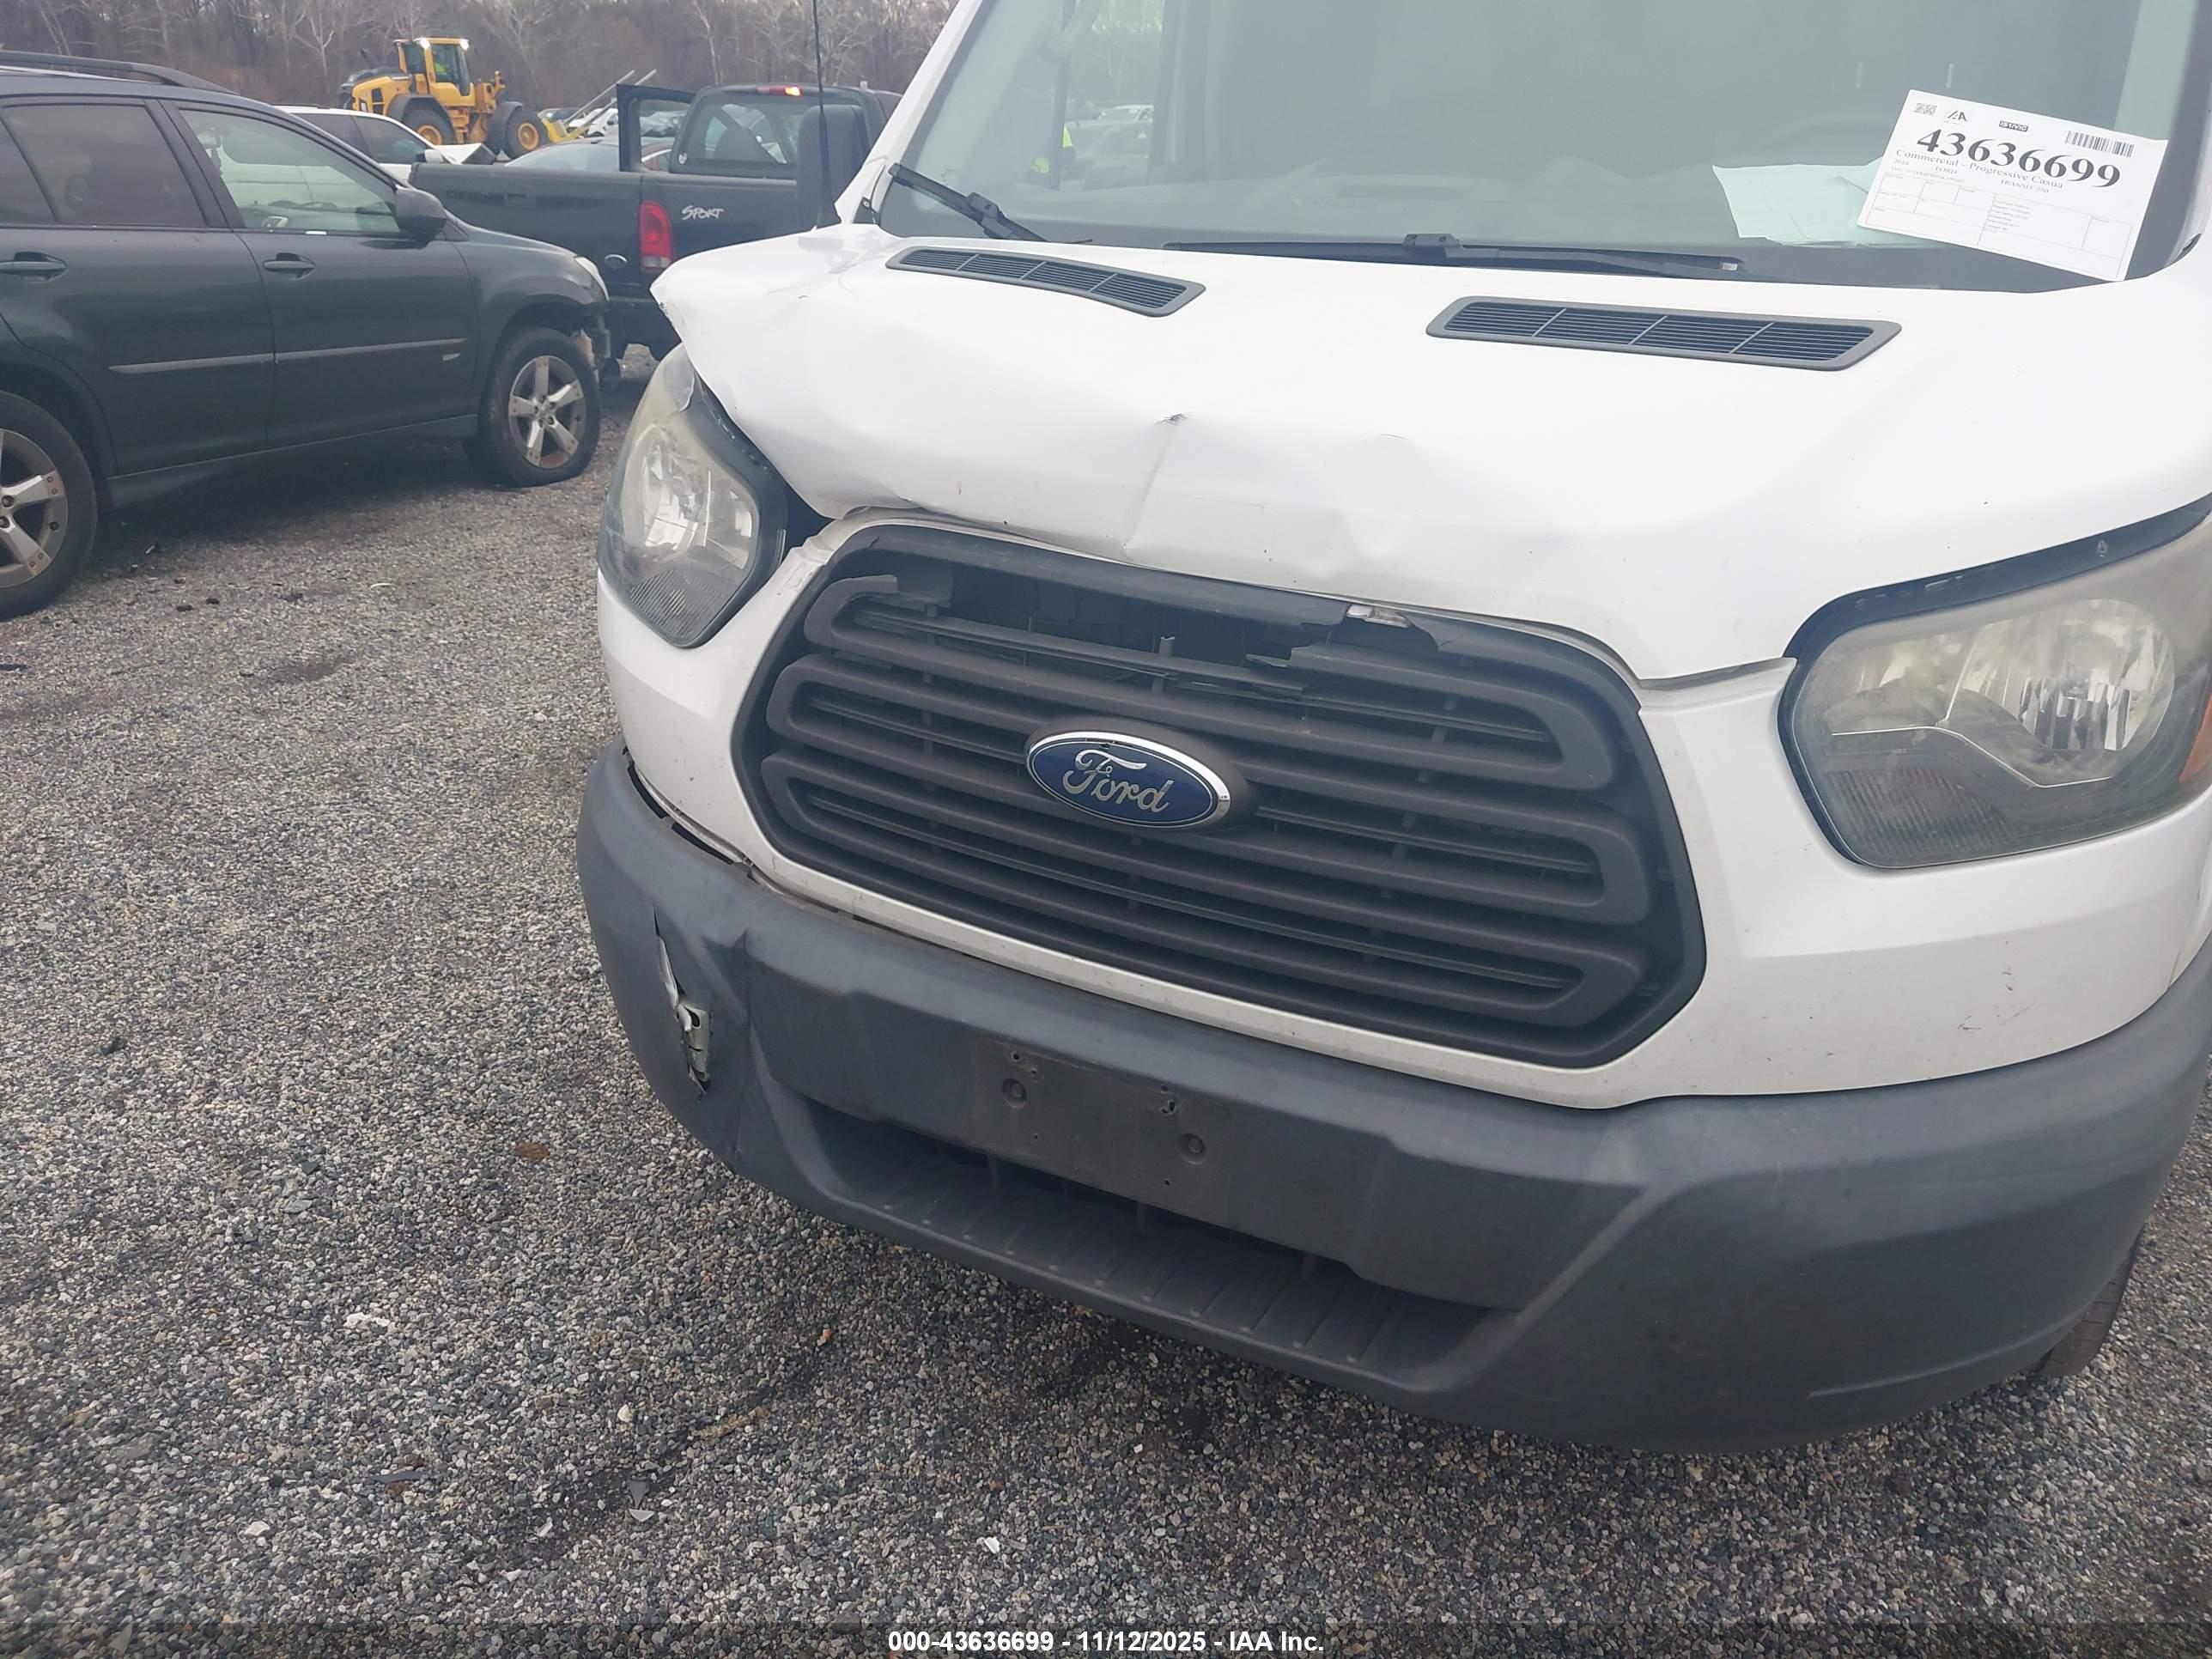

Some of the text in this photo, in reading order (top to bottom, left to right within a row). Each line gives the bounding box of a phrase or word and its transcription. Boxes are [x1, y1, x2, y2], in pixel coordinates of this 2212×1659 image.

[1895, 149, 1960, 167] Commercial
[1969, 162, 2028, 181] Progressive
[1917, 129, 2120, 188] 43636699
[1062, 749, 1175, 812] Ford
